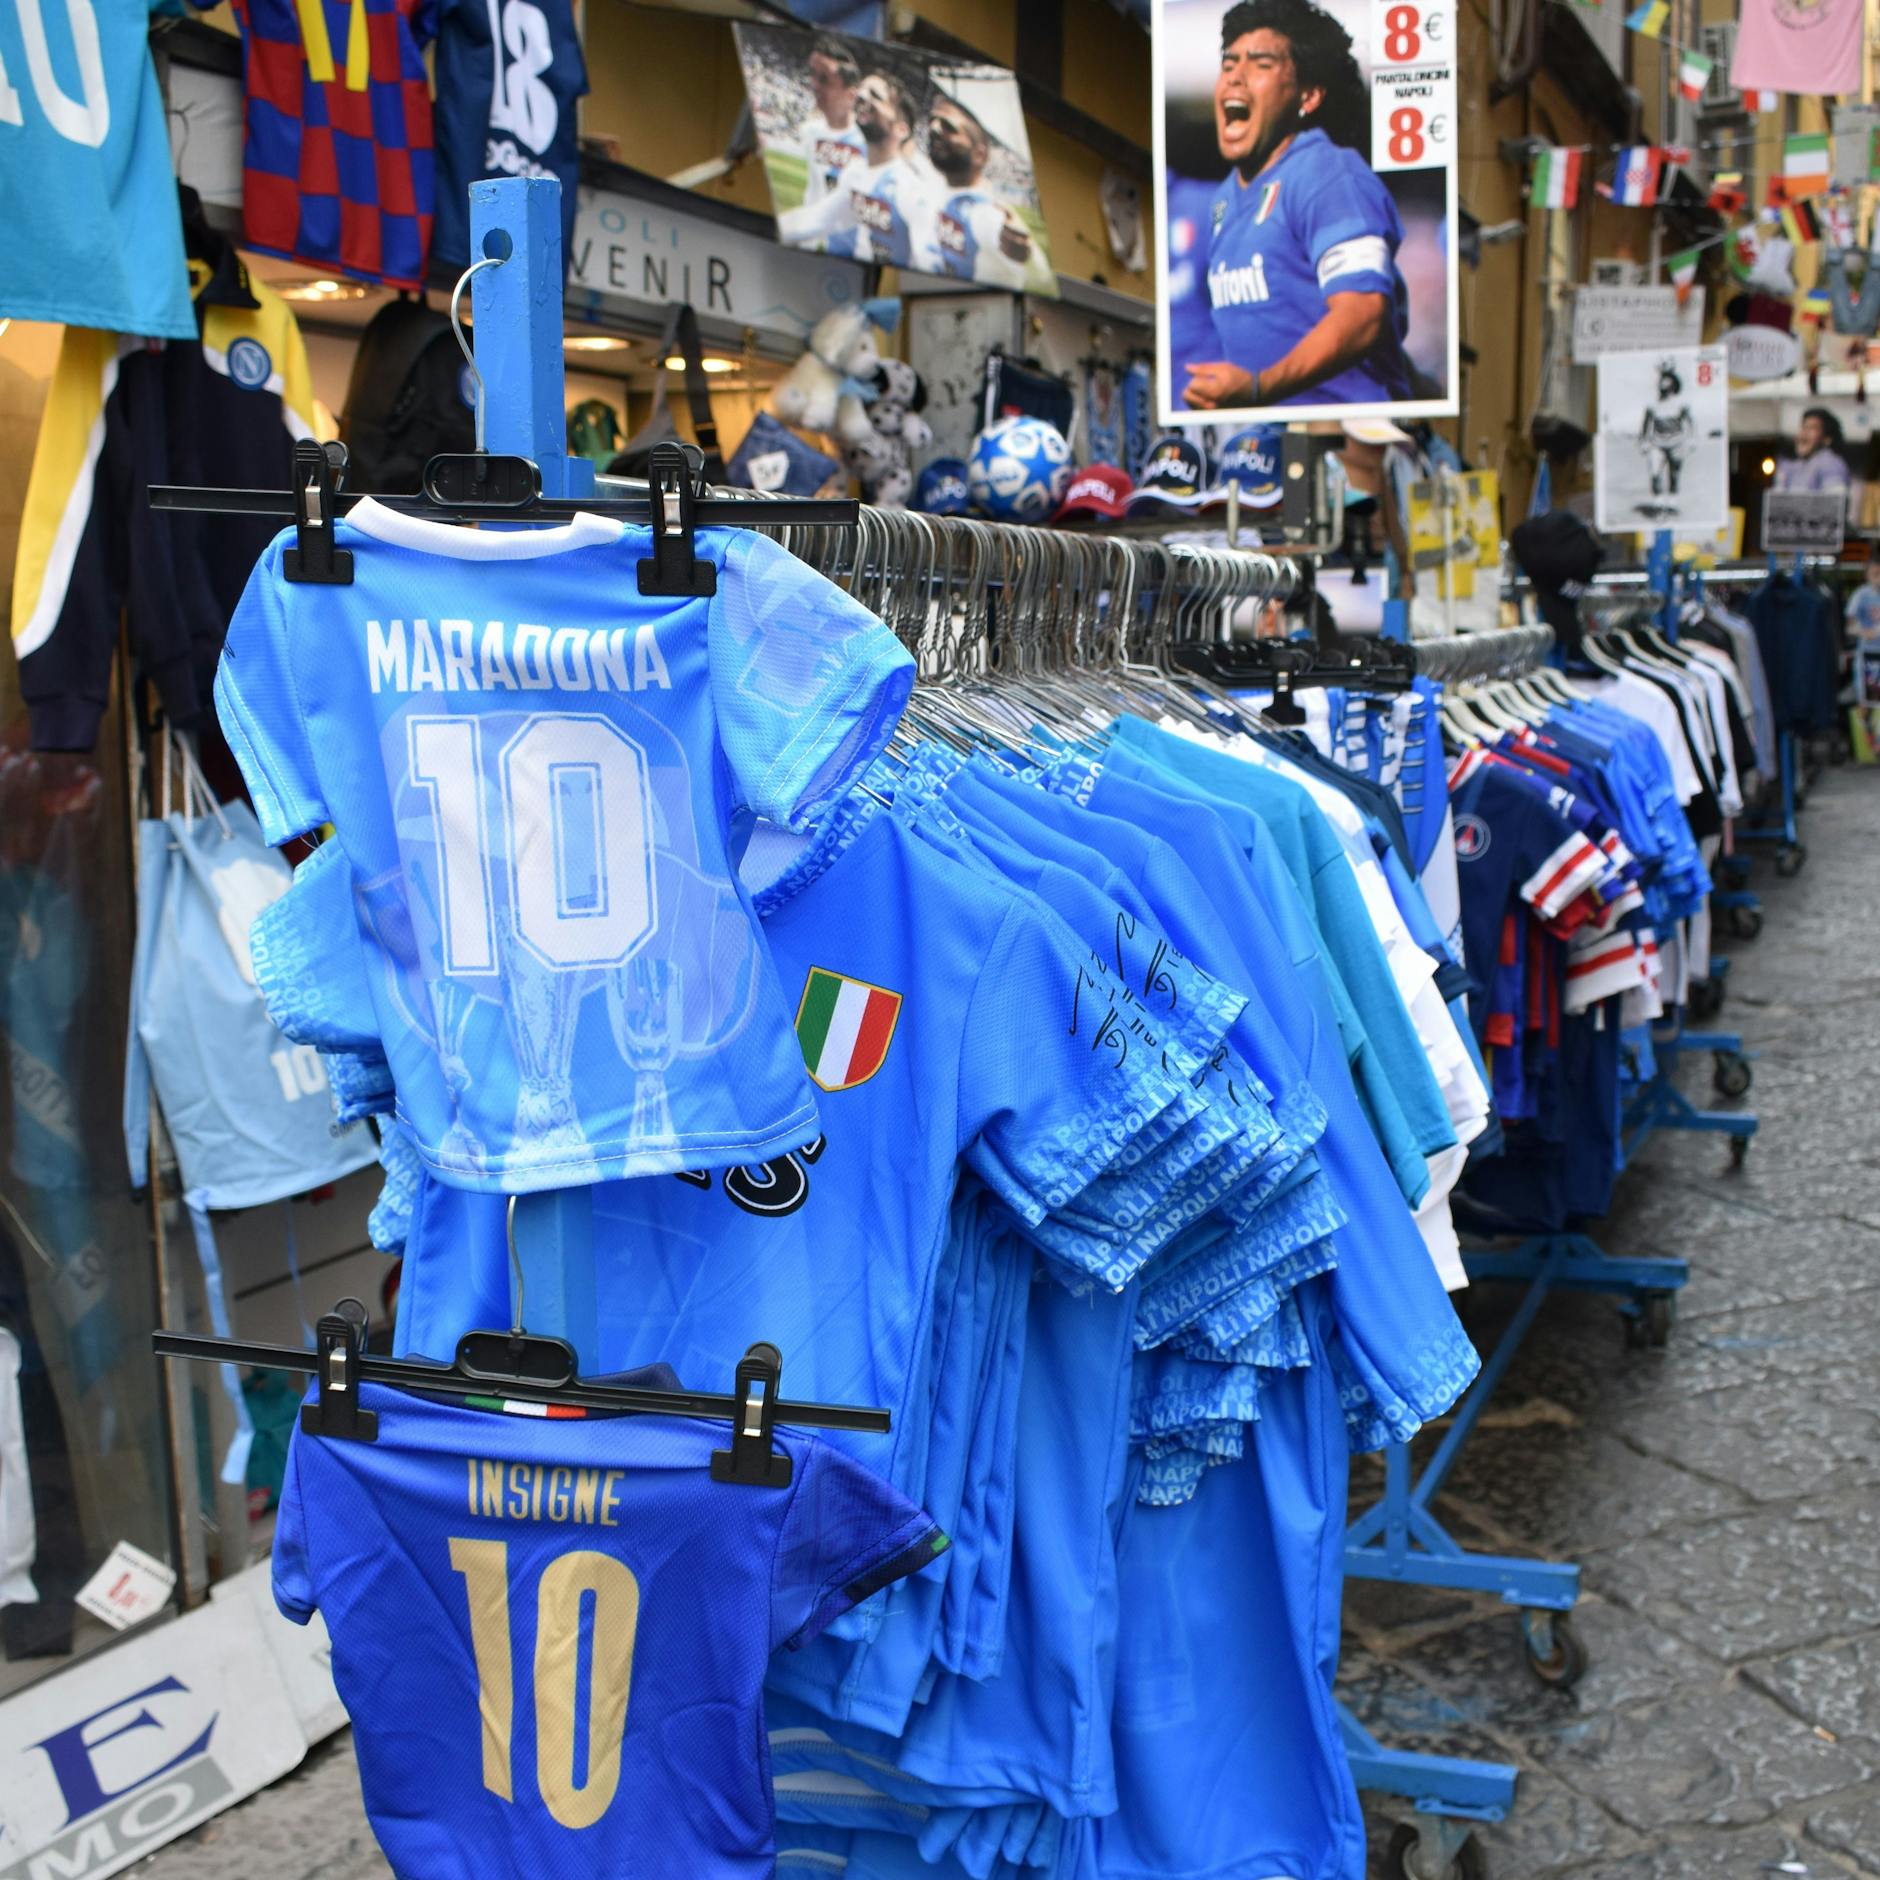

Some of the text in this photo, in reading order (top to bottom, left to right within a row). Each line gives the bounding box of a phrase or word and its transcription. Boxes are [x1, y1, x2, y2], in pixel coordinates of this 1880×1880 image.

[1393, 86, 1433, 99] NAPOLI
[600, 207, 679, 249] OLI
[366, 618, 673, 694] MARADONA
[405, 711, 659, 977] 10
[1084, 1090, 1167, 1174] NAPOLI
[1151, 1115, 1239, 1194] NAPOLI
[1158, 1263, 1244, 1322] NAPOLI
[1244, 1210, 1339, 1272] NAPOLI
[1151, 1402, 1229, 1431] NAPOLI
[467, 1459, 625, 1527] INSIGNE
[448, 1537, 640, 1830] 10
